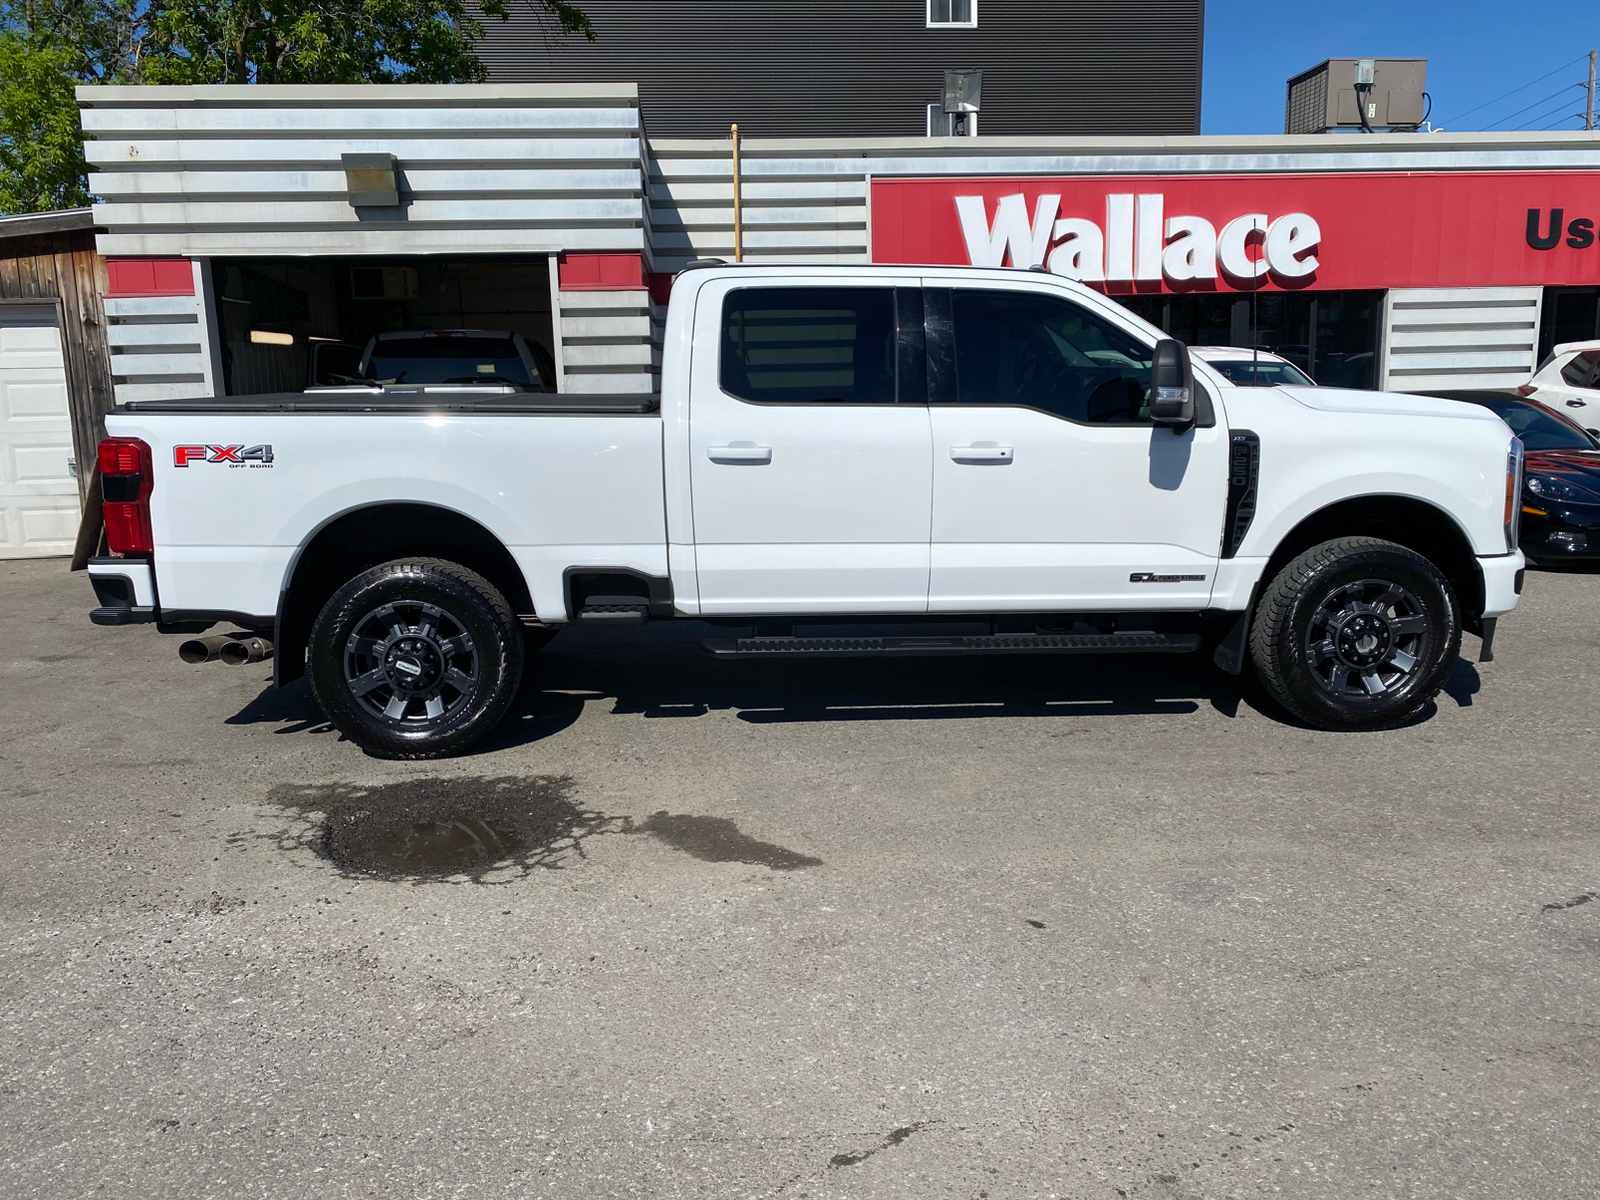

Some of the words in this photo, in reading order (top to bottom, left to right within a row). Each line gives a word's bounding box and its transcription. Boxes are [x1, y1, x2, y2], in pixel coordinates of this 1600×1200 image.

[954, 193, 1322, 282] Wallace
[1526, 208, 1600, 250] Us
[173, 444, 274, 468] FX4
[1232, 445, 1248, 486] F250
